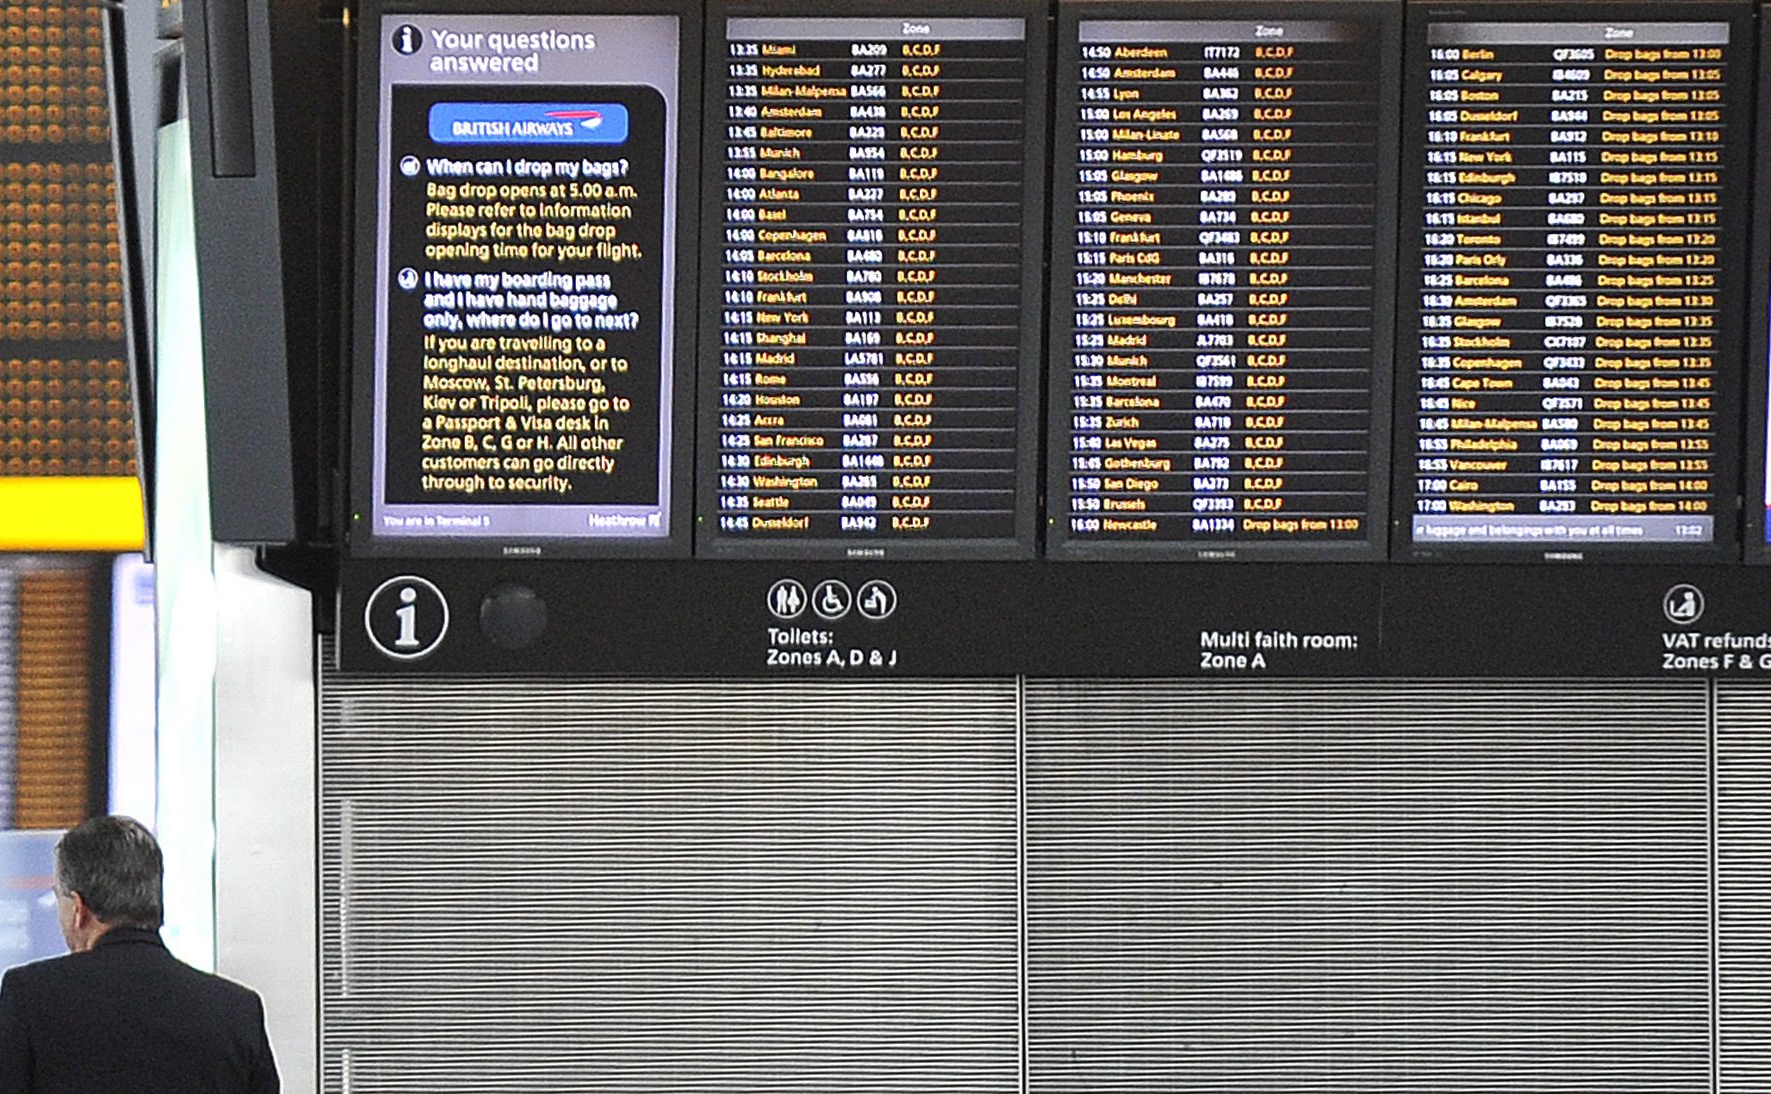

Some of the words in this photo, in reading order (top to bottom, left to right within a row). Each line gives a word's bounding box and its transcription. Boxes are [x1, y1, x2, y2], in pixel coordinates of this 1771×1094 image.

[903, 23, 930, 34] Zone
[431, 30, 484, 52] Your
[488, 30, 595, 52] questions
[430, 52, 538, 74] answered
[1114, 88, 1139, 100] Lyon
[453, 122, 510, 136] BRITISH
[512, 122, 573, 136] AIRWAYS
[426, 159, 474, 176] When
[476, 162, 504, 176] can
[506, 159, 512, 175] I
[514, 159, 552, 178] drop
[555, 162, 579, 178] my
[582, 159, 628, 178] bags?
[427, 182, 456, 200] Bag
[460, 182, 497, 200] drop
[500, 186, 546, 200] opens
[570, 183, 602, 198] 5.00
[605, 186, 637, 198] a.m.
[427, 202, 475, 218] Please
[478, 202, 516, 218] refer
[520, 204, 536, 218] to
[540, 202, 631, 218] information
[426, 222, 487, 240] displays
[490, 222, 513, 238] for
[516, 222, 542, 238] the
[546, 222, 575, 241] bag
[579, 223, 616, 241] drop
[426, 242, 490, 260] opening
[493, 242, 528, 258] time
[532, 242, 554, 258] for
[558, 241, 593, 260] your
[596, 242, 642, 261] flight.
[424, 272, 431, 288] I
[433, 271, 472, 289] have
[474, 274, 499, 291] my
[502, 271, 572, 291] boarding
[575, 275, 610, 291] pass
[424, 291, 455, 309] and
[457, 292, 464, 308] I
[466, 290, 504, 308] have
[507, 291, 547, 308] hand
[549, 290, 617, 311] baggage
[757, 291, 806, 302] Frankfurt
[423, 311, 463, 332] only,
[466, 311, 516, 328] where
[518, 311, 540, 329] do
[543, 312, 548, 328] I
[550, 313, 573, 332] go
[575, 312, 592, 329] to
[595, 310, 638, 330] next?
[757, 312, 781, 323] New
[784, 311, 808, 323] York
[424, 334, 436, 350] If
[439, 338, 467, 353] you
[470, 338, 496, 350] are
[499, 336, 572, 353] travelling
[576, 337, 592, 351] to
[596, 339, 606, 351] a
[424, 355, 492, 373] longhaul
[495, 353, 586, 373] destination,
[590, 359, 607, 371] or
[611, 358, 628, 372] to
[424, 375, 490, 392] Moscow,
[495, 375, 514, 390] St.
[518, 376, 605, 393] Petersburg,
[424, 395, 456, 410] Kiev
[459, 398, 476, 410] or
[480, 395, 532, 412] Tripoli,
[537, 396, 586, 413] please
[589, 393, 610, 414] go
[613, 397, 630, 411] to
[422, 418, 432, 430] a
[436, 415, 500, 432] Passport
[506, 416, 517, 430] &
[521, 416, 552, 430] Visa
[555, 416, 590, 430] desk
[595, 415, 608, 430] in
[422, 435, 461, 450] Zone
[465, 435, 478, 451] B,
[482, 435, 496, 451] C,
[501, 435, 512, 450] G
[516, 438, 534, 450] or
[537, 436, 552, 450] H.
[556, 435, 577, 450] All
[581, 435, 623, 450] other
[422, 456, 500, 470] customers
[503, 458, 530, 470] can
[534, 458, 554, 473] go
[557, 455, 614, 473] directly
[422, 474, 484, 493] through
[488, 476, 505, 490] to
[508, 475, 572, 493] security.
[1592, 480, 1620, 492] Drop
[1621, 480, 1647, 492] bags
[1650, 480, 1676, 490] from
[384, 516, 403, 526] You
[406, 518, 422, 526] are
[424, 516, 434, 526] in
[436, 516, 481, 526] Terminal
[484, 516, 490, 526] 5
[589, 514, 646, 527] Heathrow
[752, 516, 809, 528] Dusseldorf
[1104, 519, 1156, 530] Newcastle
[1244, 519, 1271, 532] Drop
[1273, 519, 1298, 532] bags
[1301, 519, 1327, 530] from
[1468, 525, 1487, 535] and
[1569, 527, 1587, 538] you
[768, 628, 833, 644] Toilets:
[1201, 632, 1249, 648] Multi
[1255, 631, 1297, 648] faith
[1303, 636, 1357, 648] room:
[1663, 633, 1700, 648] VAT
[767, 649, 821, 664] Zones
[826, 650, 845, 667] A,
[850, 650, 863, 665] D
[870, 650, 882, 665] &
[889, 650, 896, 666] J
[1201, 652, 1246, 668] Zone
[1252, 653, 1266, 668] A
[1663, 654, 1718, 668] Zones
[1724, 654, 1734, 668] F
[1739, 654, 1752, 668] &
